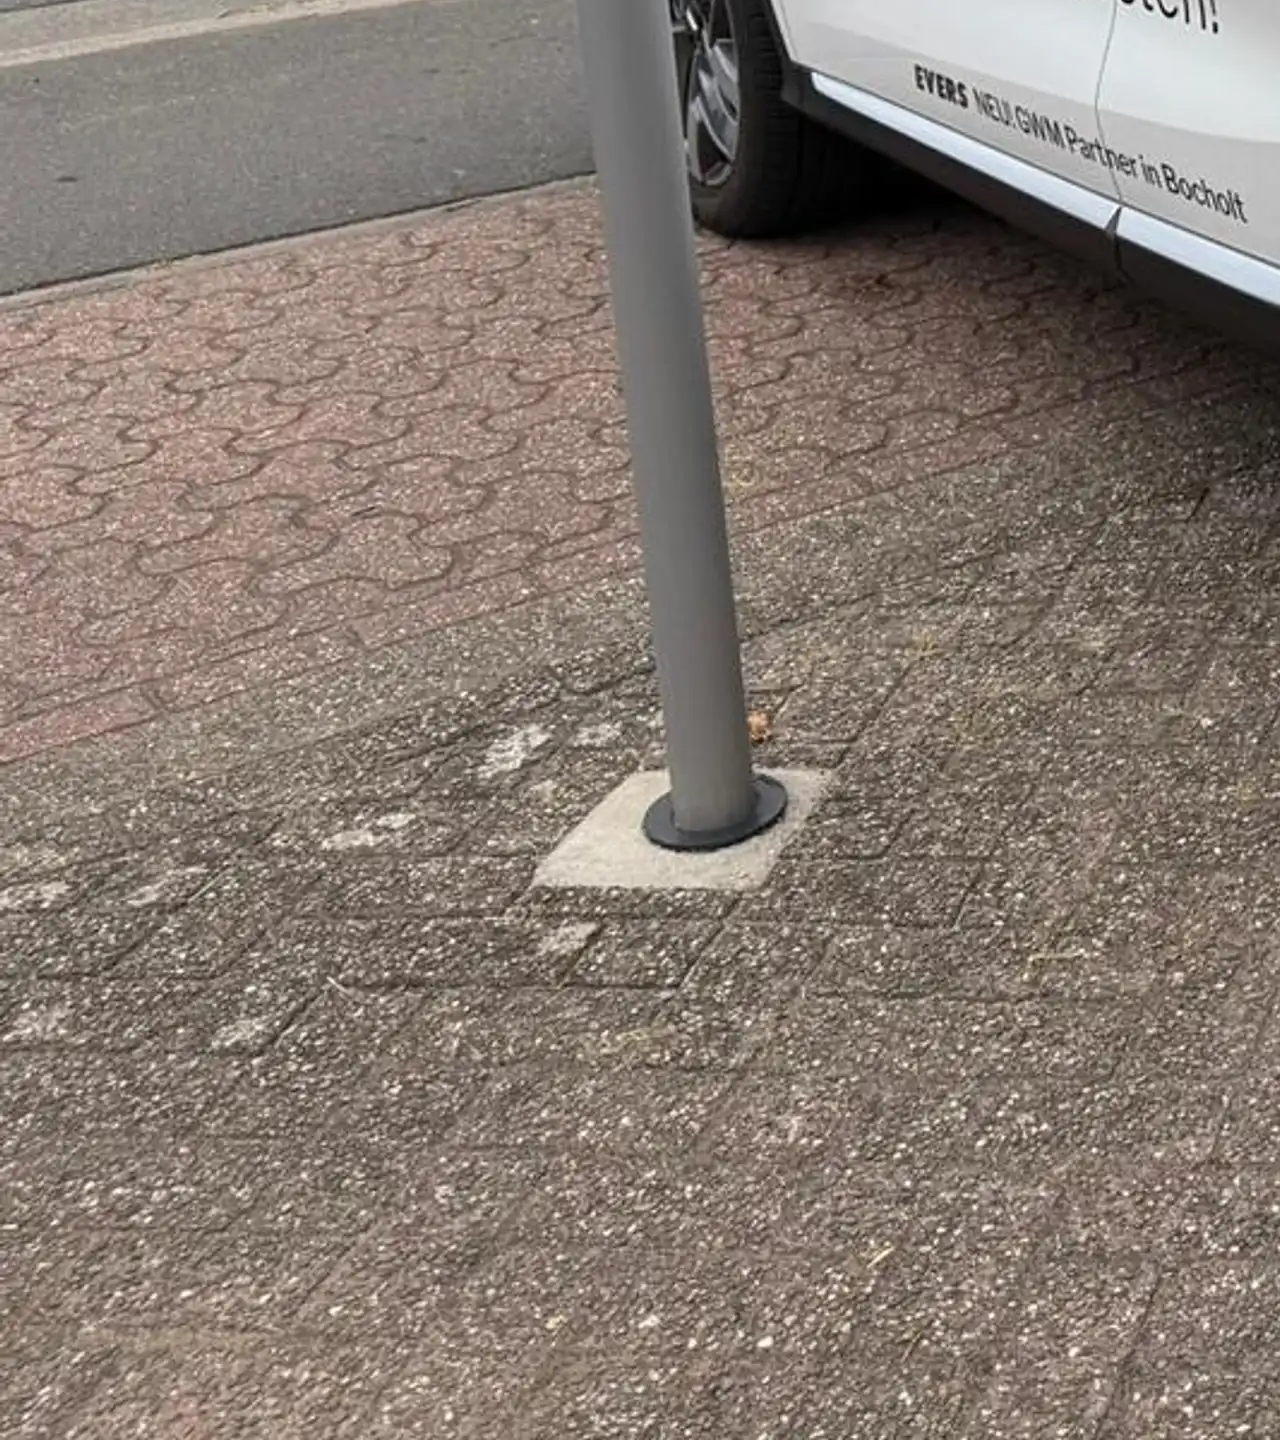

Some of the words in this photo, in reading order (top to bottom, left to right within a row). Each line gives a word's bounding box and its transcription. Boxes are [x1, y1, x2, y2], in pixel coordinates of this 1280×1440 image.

[914, 64, 970, 109] EVERS
[1015, 105, 1066, 150] GWM
[1066, 124, 1140, 178] Partner
[1139, 154, 1163, 190] in
[1162, 164, 1248, 224] Bocholt
